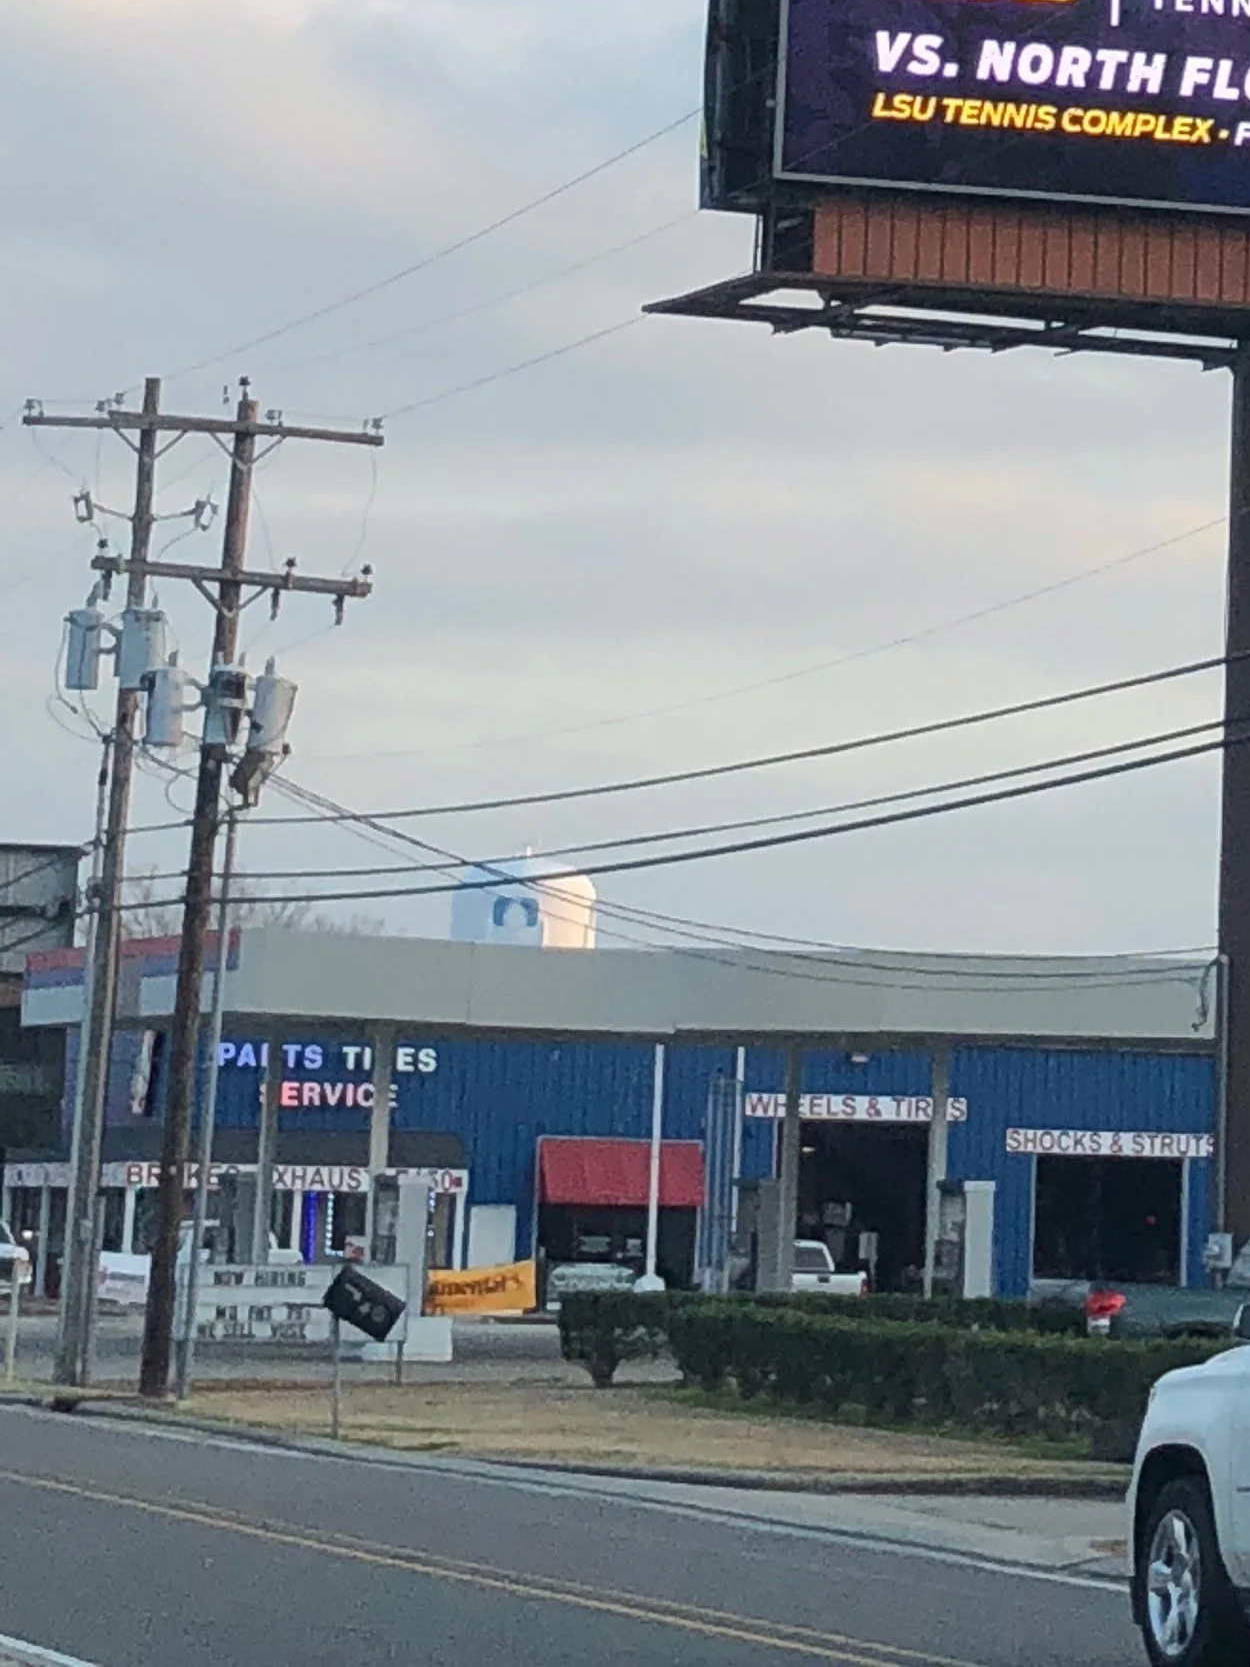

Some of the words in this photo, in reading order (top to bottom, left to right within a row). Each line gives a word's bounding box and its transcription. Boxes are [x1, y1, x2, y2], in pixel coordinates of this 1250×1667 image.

[875, 30, 960, 78] VS.
[976, 39, 1168, 94] NORTH
[872, 92, 937, 122] LSU
[942, 97, 1058, 132] TENNIS
[1061, 108, 1214, 144] COMPLEX
[342, 1045, 438, 1072] TIES
[867, 1096, 882, 1118] &
[892, 1096, 966, 1121] TIRS
[1007, 1129, 1102, 1153] SHOCKS
[1110, 1131, 1123, 1154] &
[127, 1163, 238, 1190] BRKE
[274, 1166, 370, 1191] XHAUS
